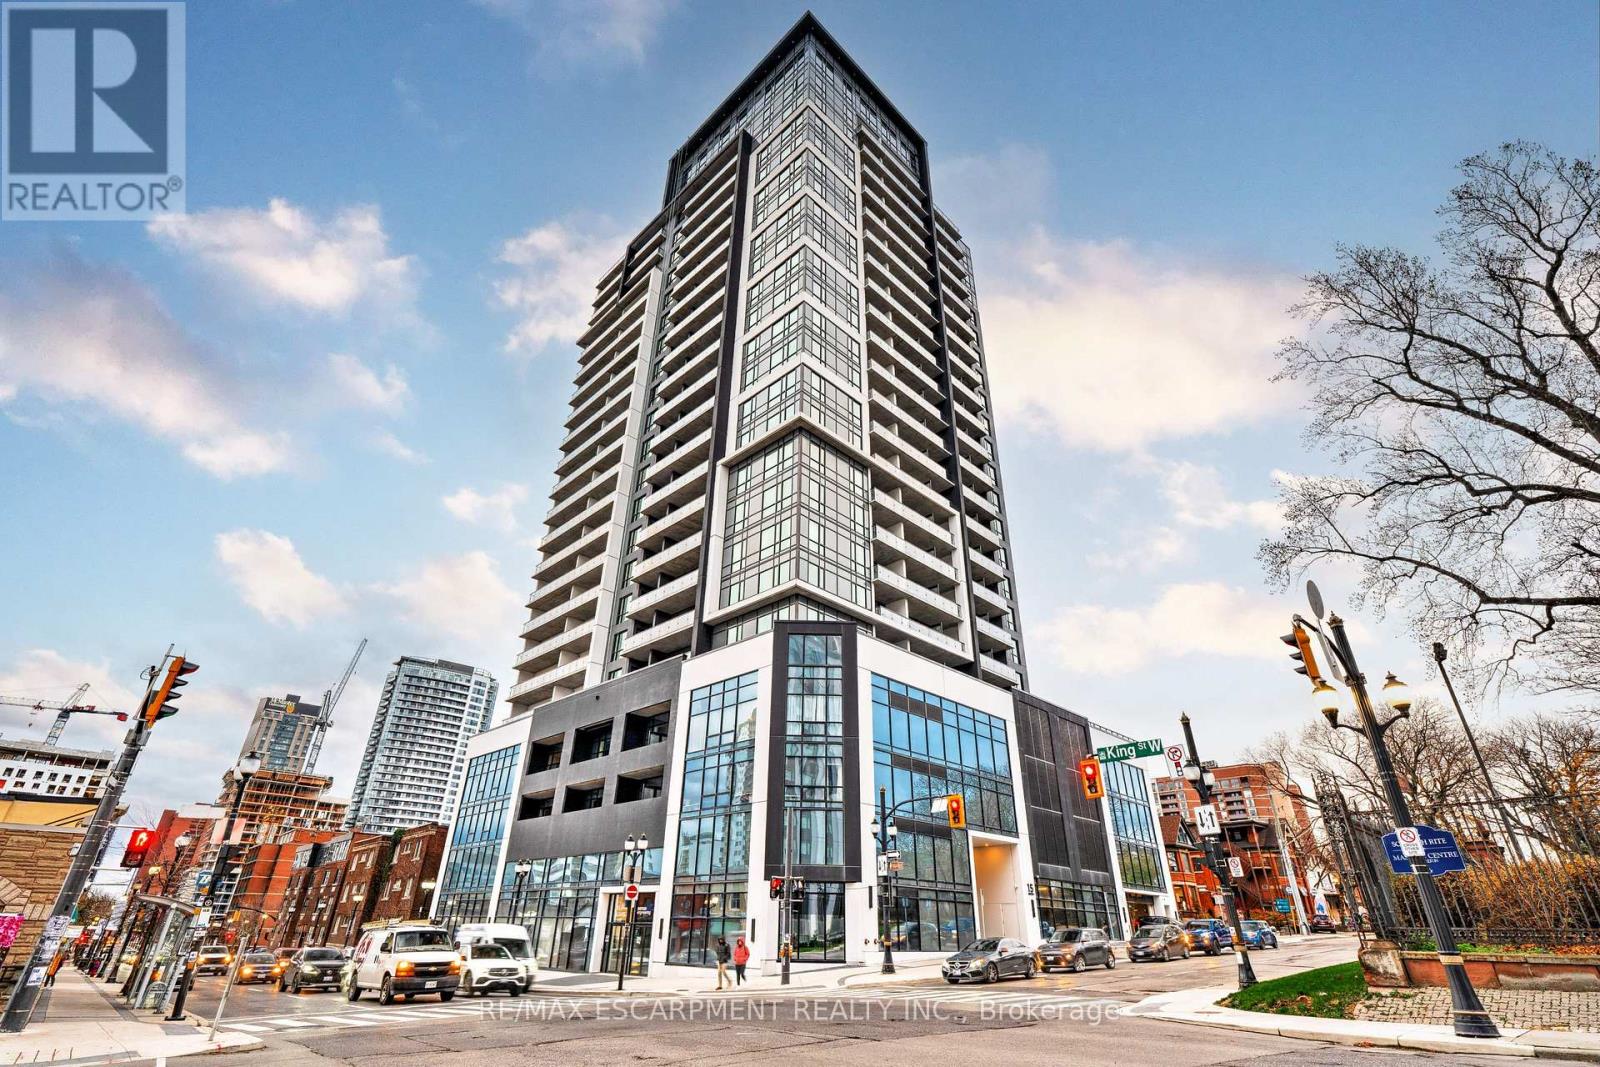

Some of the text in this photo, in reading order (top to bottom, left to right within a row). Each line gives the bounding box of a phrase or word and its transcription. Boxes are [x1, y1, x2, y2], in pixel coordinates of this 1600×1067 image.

[1106, 739, 1161, 759] King St W
[1429, 837, 1447, 845] RITE
[1427, 851, 1459, 859] CENTRE
[1027, 883, 1033, 892] 15
